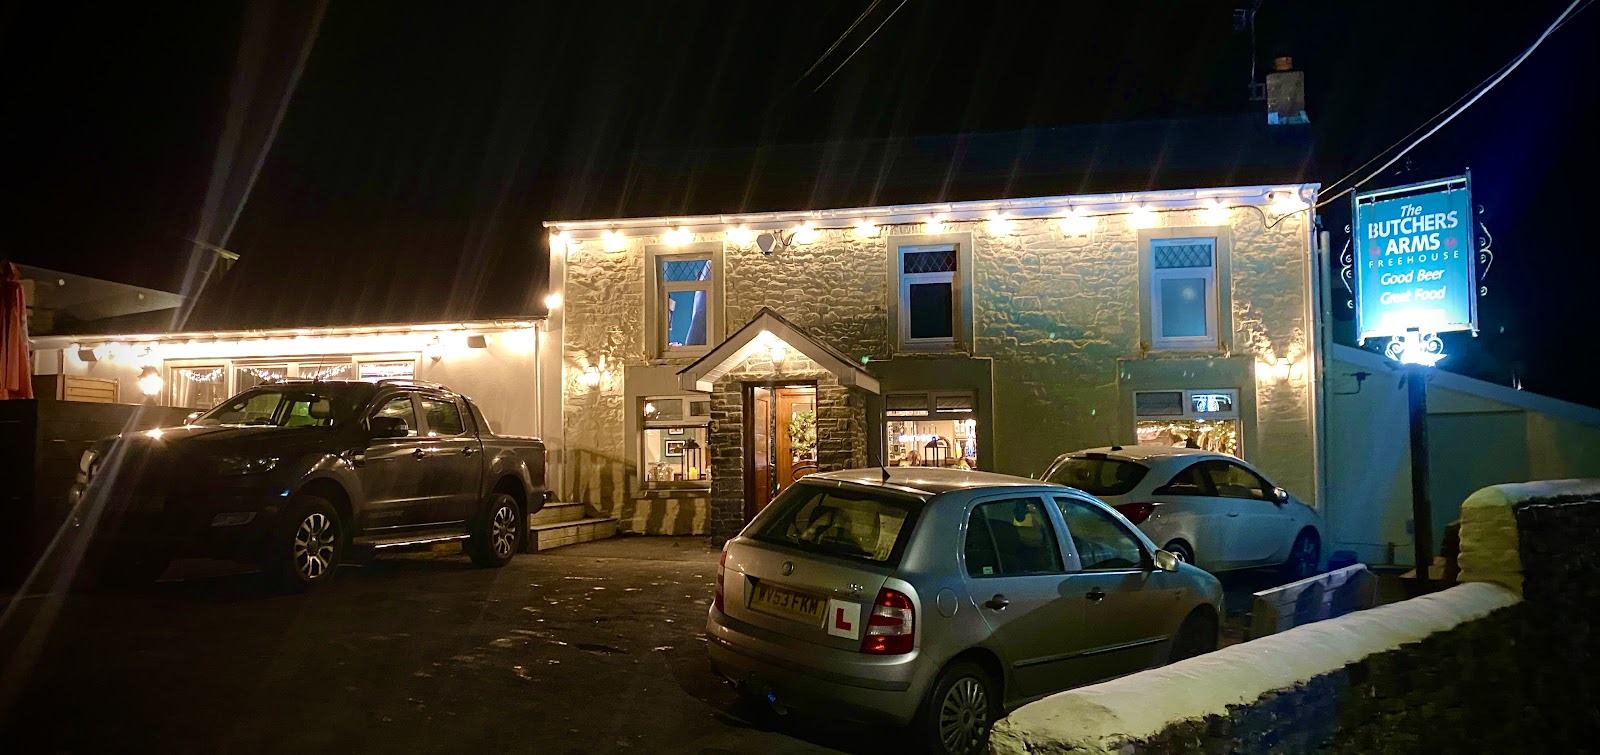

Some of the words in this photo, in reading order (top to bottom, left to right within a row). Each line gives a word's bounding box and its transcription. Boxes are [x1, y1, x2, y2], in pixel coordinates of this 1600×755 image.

[1400, 203, 1422, 218] The
[1368, 210, 1458, 239] BUTCHERS
[1385, 233, 1441, 256] ARMS
[1368, 250, 1459, 269] FREEHOUSE
[1380, 269, 1414, 286] Good
[1417, 269, 1445, 282] Beer
[1413, 285, 1447, 301] Food
[835, 607, 852, 631] L
